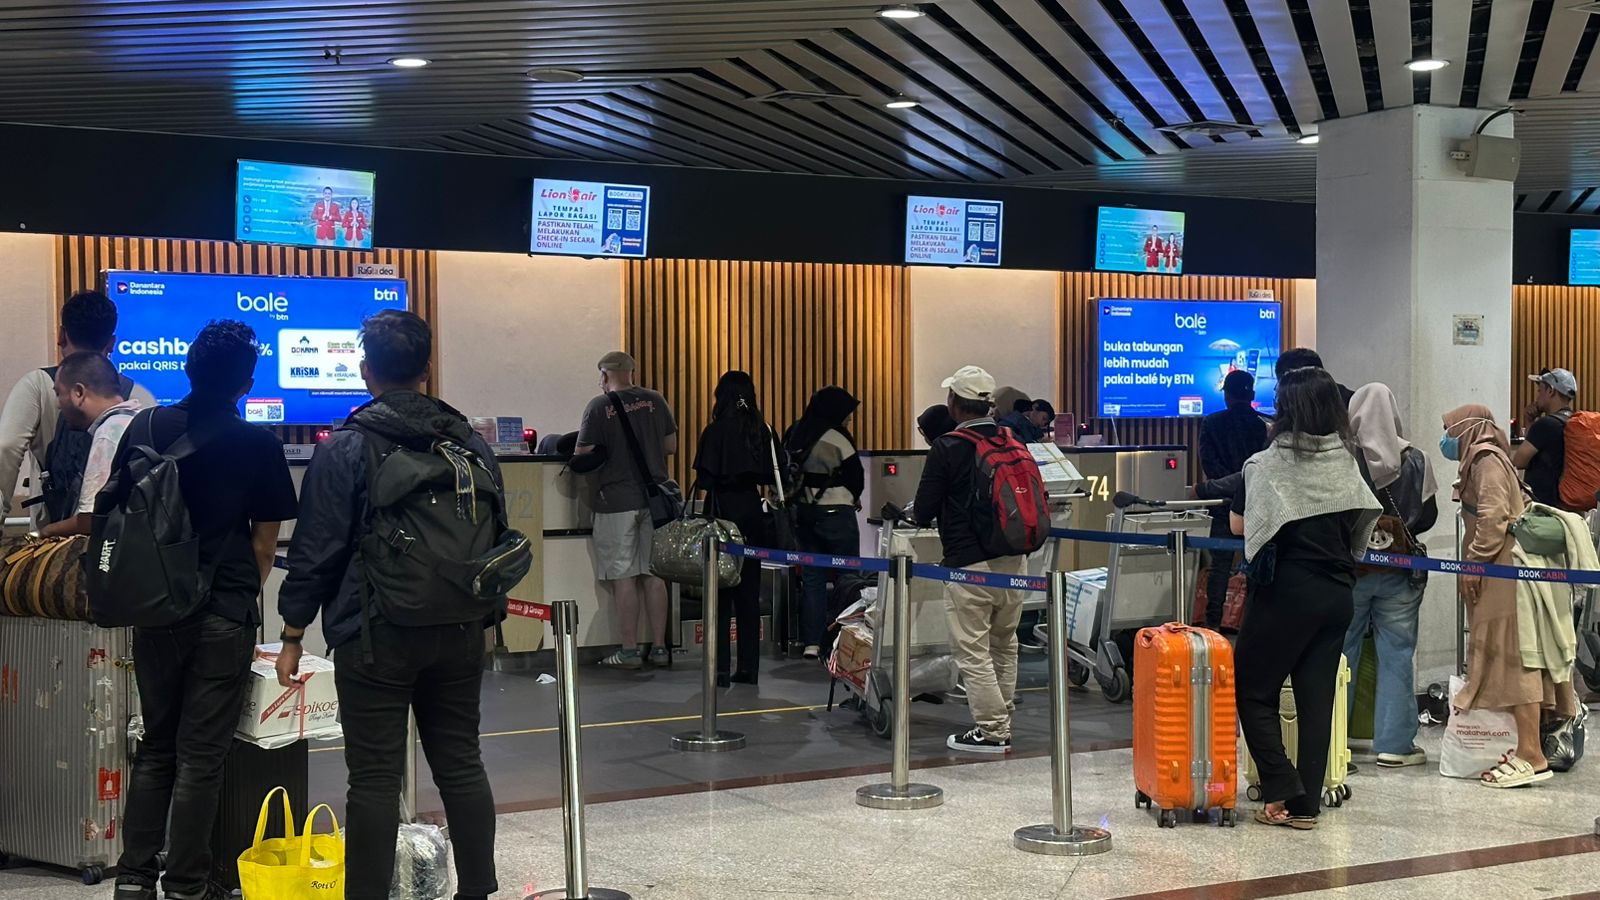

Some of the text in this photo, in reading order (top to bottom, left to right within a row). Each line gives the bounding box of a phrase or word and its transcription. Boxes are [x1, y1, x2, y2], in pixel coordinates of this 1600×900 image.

[541, 189, 597, 201] Lion air
[913, 205, 960, 215] Lion air
[537, 221, 571, 229] PASTIKAN
[374, 287, 398, 300] btn
[276, 313, 289, 321] btn
[1260, 308, 1275, 319] btn
[118, 337, 192, 356] cashb
[1104, 341, 1183, 355] buka tabungan
[119, 360, 151, 372] pakai
[153, 361, 178, 371] QRIS
[1104, 357, 1169, 368] lebih mudah
[1104, 373, 1194, 388] pakai balé by BTN
[1087, 475, 1110, 502] 74
[1370, 553, 1412, 566] BOOKCABIN
[1440, 561, 1485, 574] BOOKCABIN
[1518, 569, 1567, 580] BOOKCABIN
[1456, 729, 1510, 737] matahari.com
